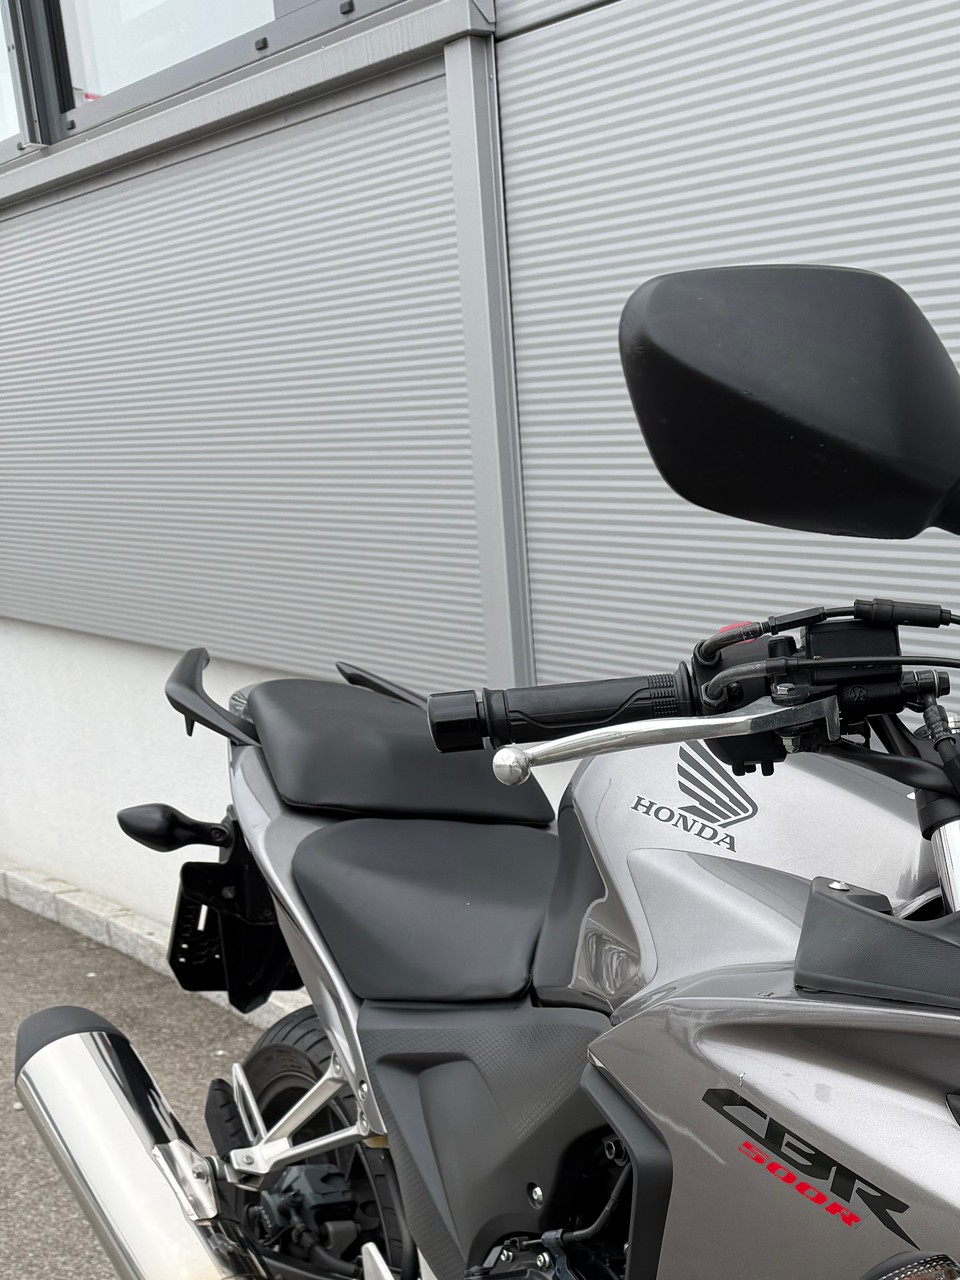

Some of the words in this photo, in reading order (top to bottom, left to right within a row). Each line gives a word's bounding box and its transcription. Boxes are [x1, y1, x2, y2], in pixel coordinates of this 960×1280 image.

[631, 795, 737, 853] HONDA
[701, 1088, 921, 1251] CBR
[738, 1140, 861, 1227] 500R
